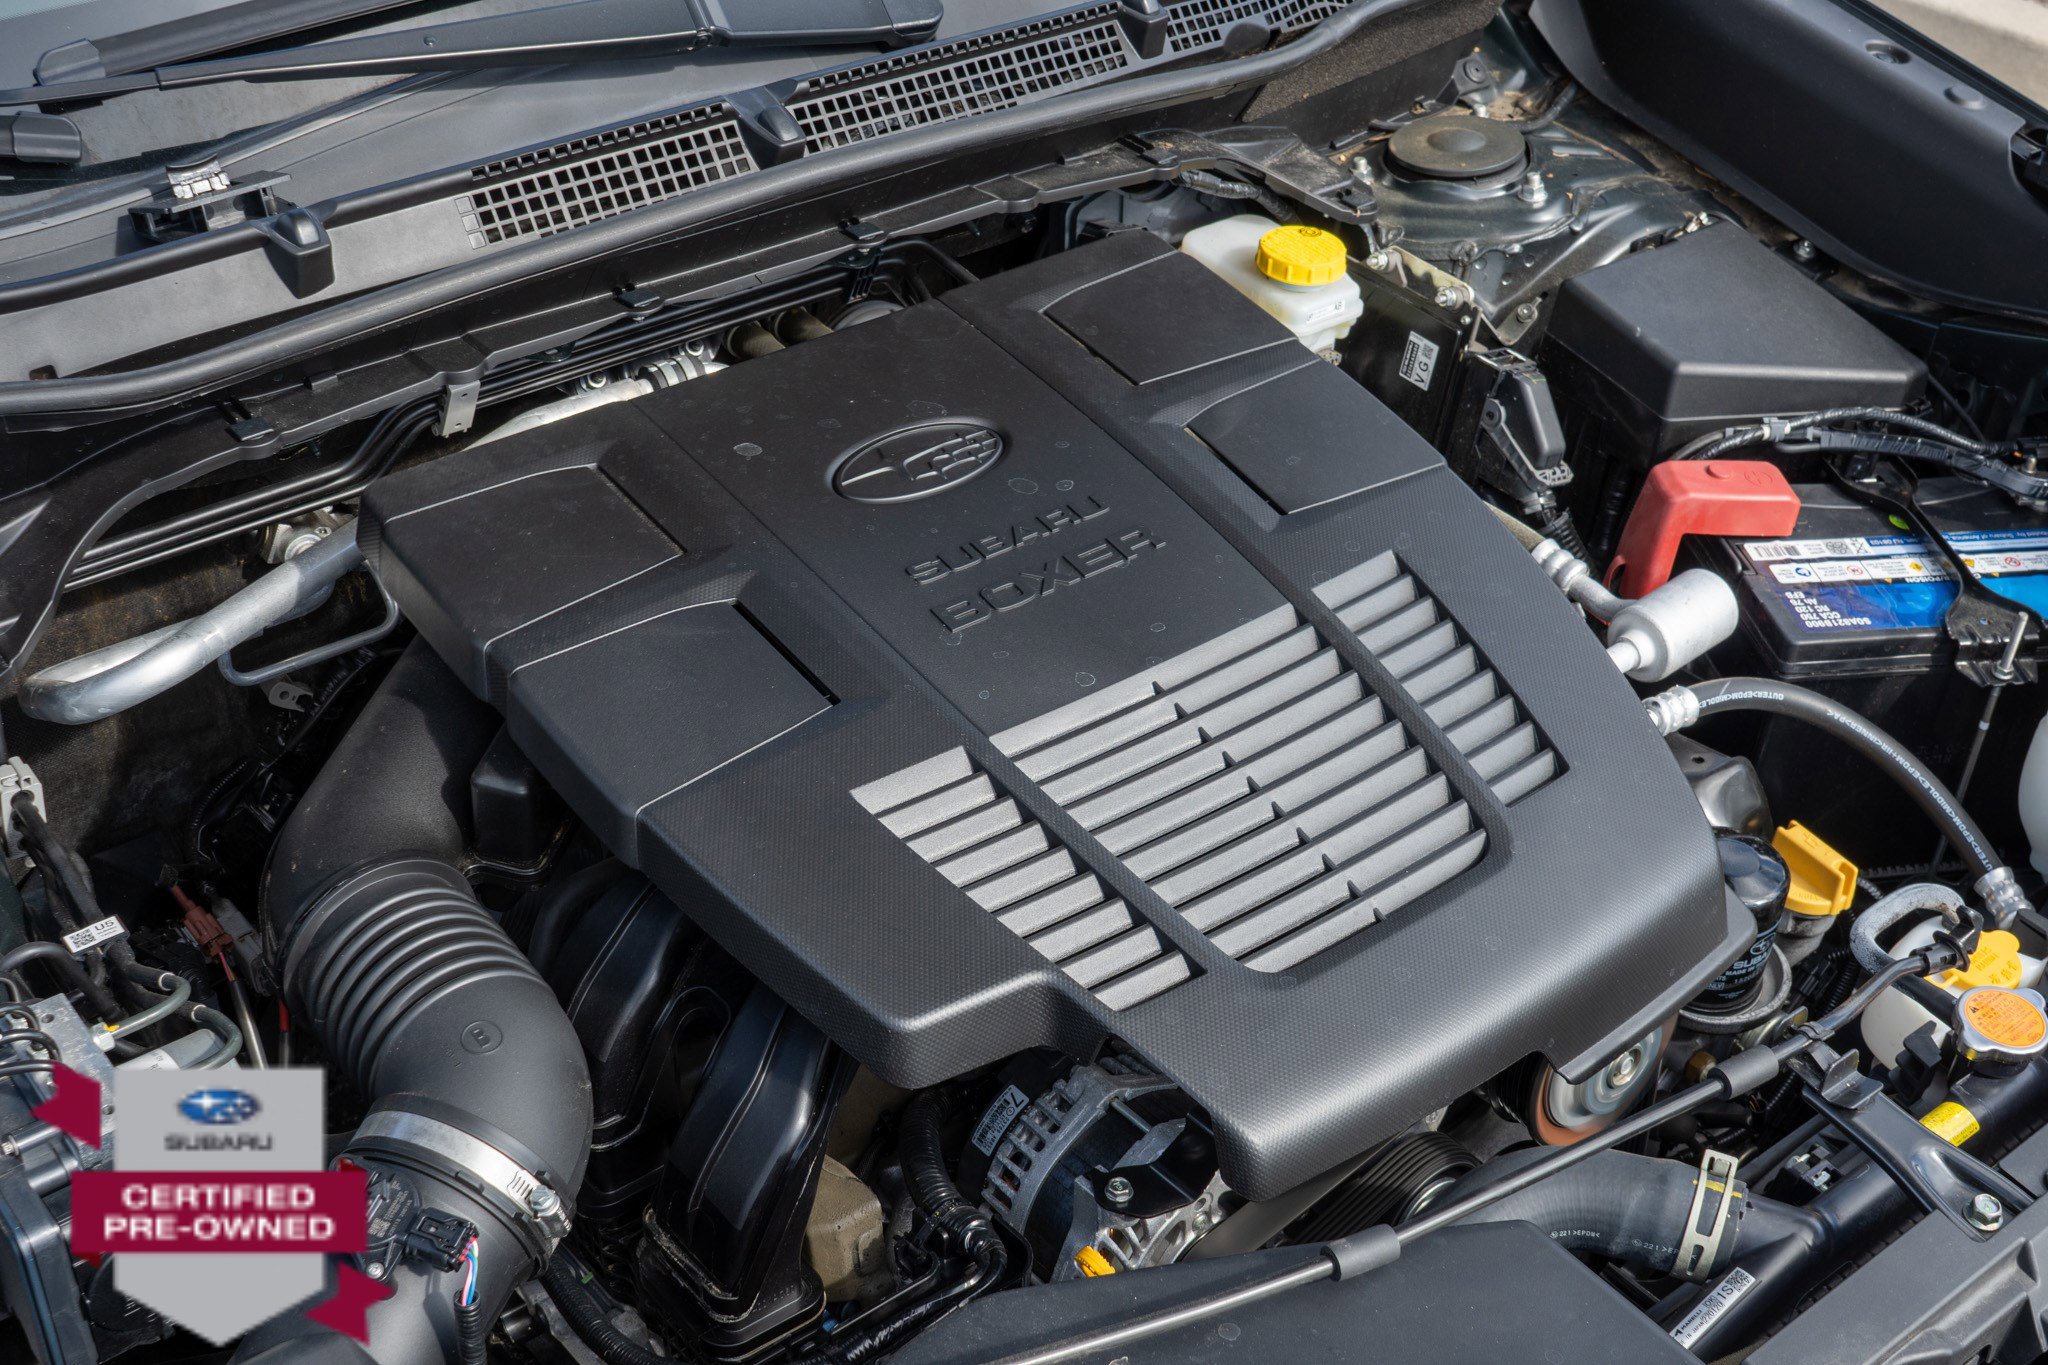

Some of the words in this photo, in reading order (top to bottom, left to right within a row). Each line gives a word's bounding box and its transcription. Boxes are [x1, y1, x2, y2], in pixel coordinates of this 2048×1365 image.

[905, 495, 1110, 585] SUBARU
[929, 529, 1167, 633] BOXER
[1794, 605, 1814, 613] 120
[1819, 611, 1840, 619] CCA
[1733, 952, 1767, 970] SUBA
[1011, 1092, 1024, 1108] 7
[1717, 1285, 1734, 1300] 1S
[1681, 1309, 1702, 1330] MARELLI
